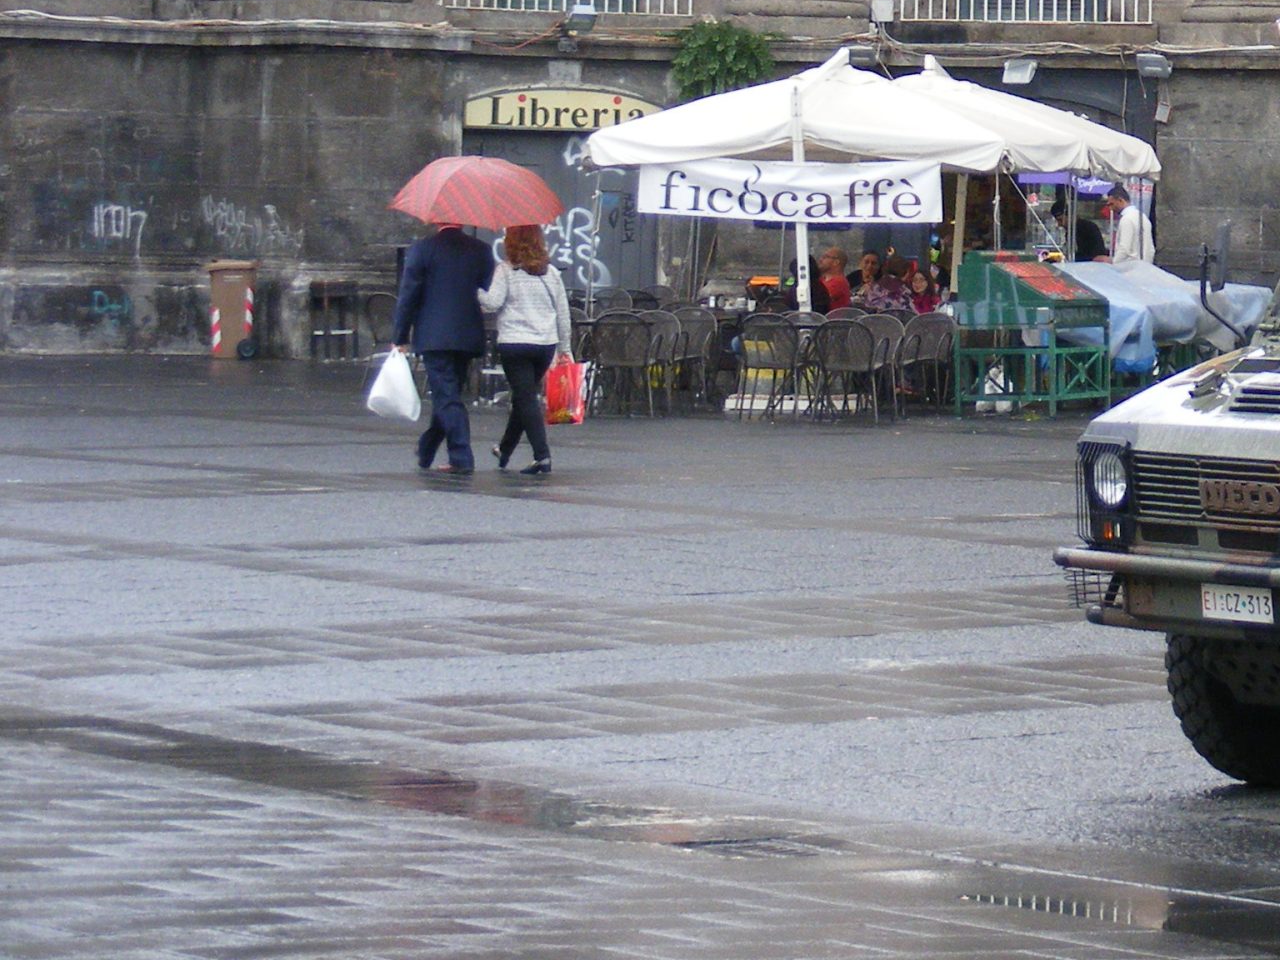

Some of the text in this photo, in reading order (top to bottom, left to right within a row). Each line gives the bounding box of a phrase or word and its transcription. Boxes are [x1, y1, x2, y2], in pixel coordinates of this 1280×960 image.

[1203, 591, 1271, 616] EI CZ 313
